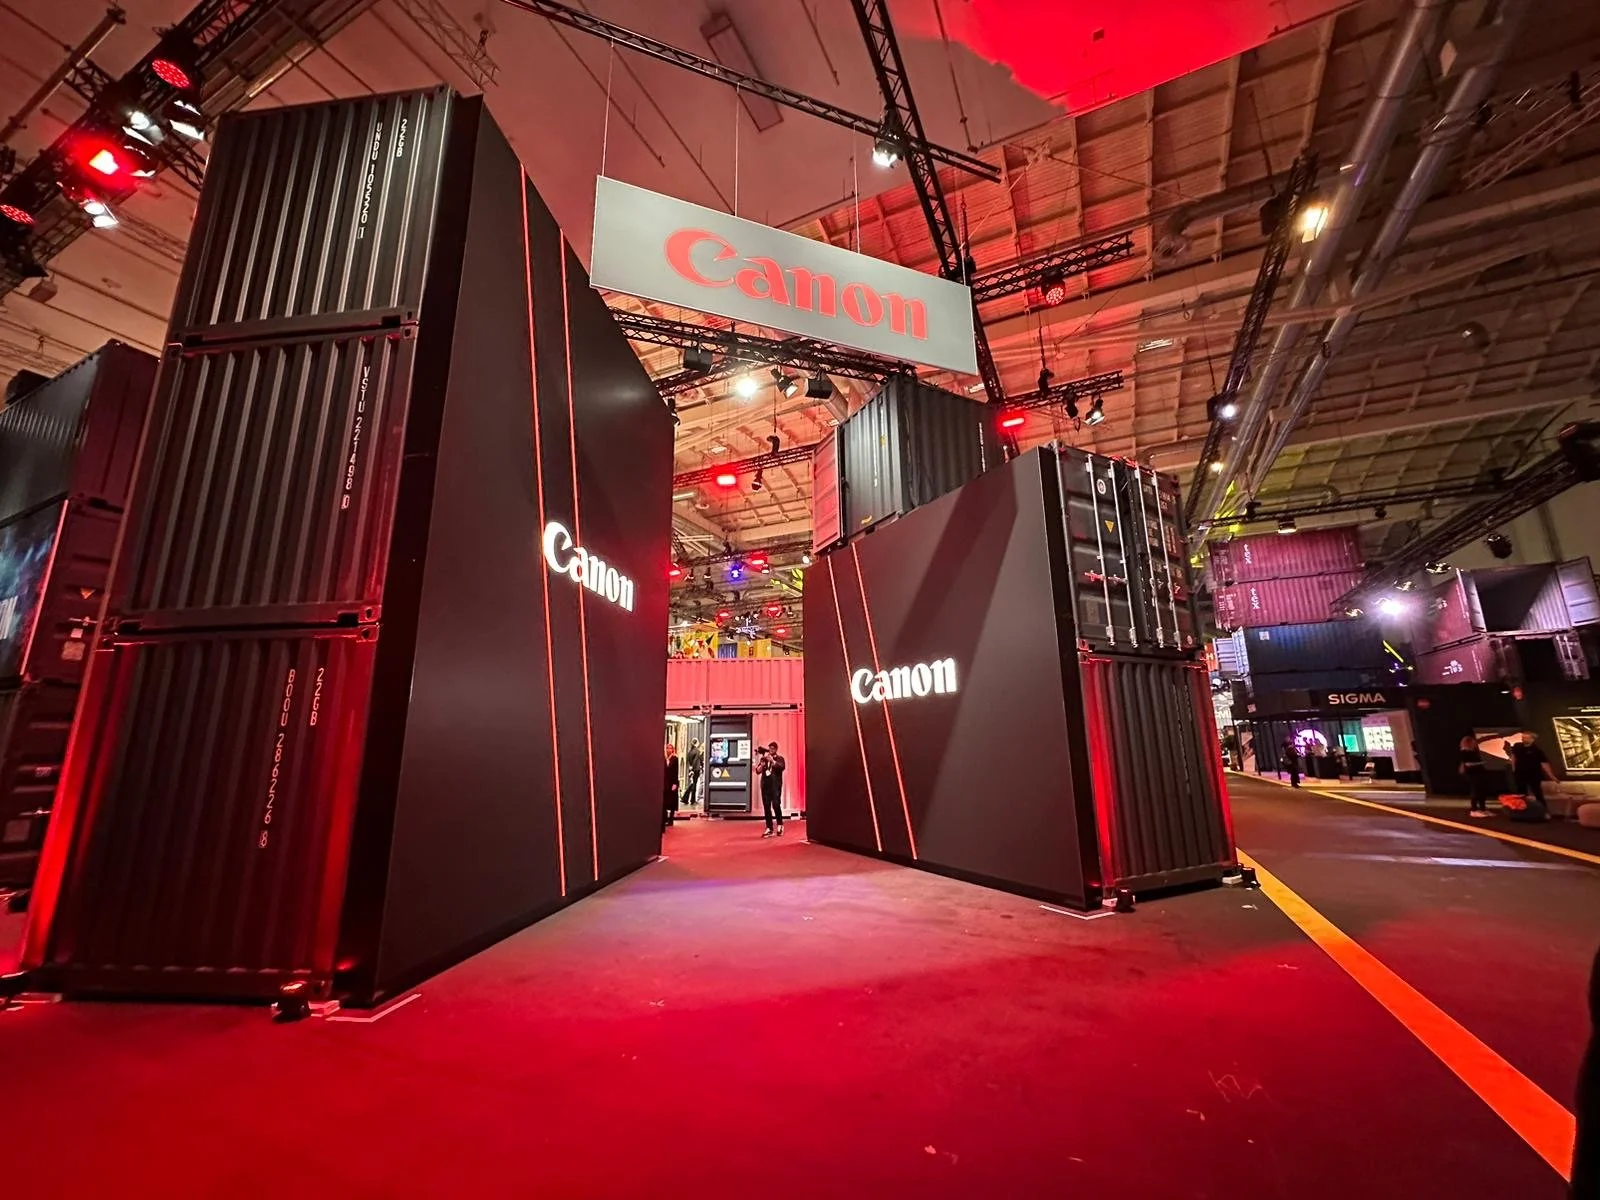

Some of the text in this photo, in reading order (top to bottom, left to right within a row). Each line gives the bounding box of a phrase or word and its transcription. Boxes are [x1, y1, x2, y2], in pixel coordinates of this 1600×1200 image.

[371, 122, 383, 161] UNDU
[664, 227, 928, 342] Canon
[358, 366, 371, 413] VSTU
[345, 416, 363, 490] 221498
[543, 521, 634, 613] Canon
[310, 667, 325, 726] 22GB
[850, 657, 957, 704] Canon
[1328, 692, 1387, 705] SIGMA
[263, 733, 285, 824] 286226
